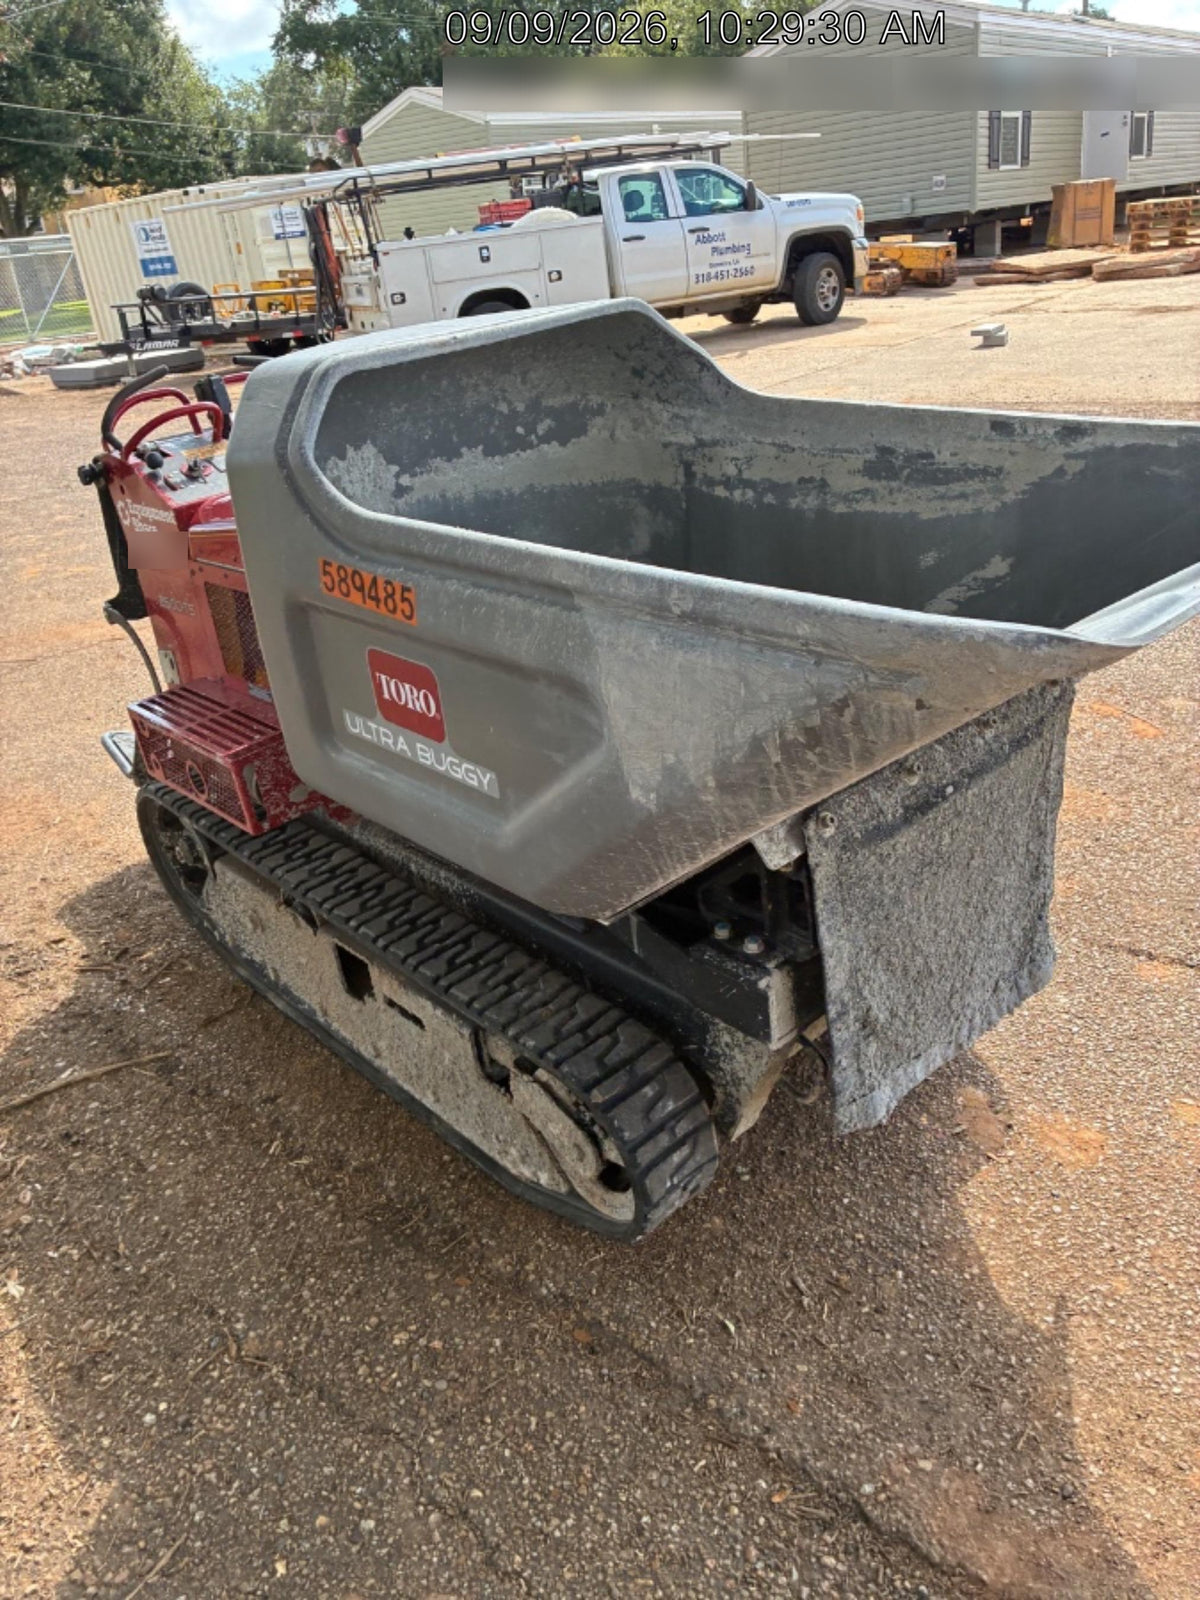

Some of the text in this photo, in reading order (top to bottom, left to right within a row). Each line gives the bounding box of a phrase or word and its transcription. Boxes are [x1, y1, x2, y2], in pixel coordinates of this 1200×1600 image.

[695, 232, 726, 245] Abbott
[710, 242, 751, 257] Plumbing
[322, 559, 414, 622] 589485
[375, 671, 436, 718] TORO
[345, 713, 492, 791] ULTRA BUGGY
